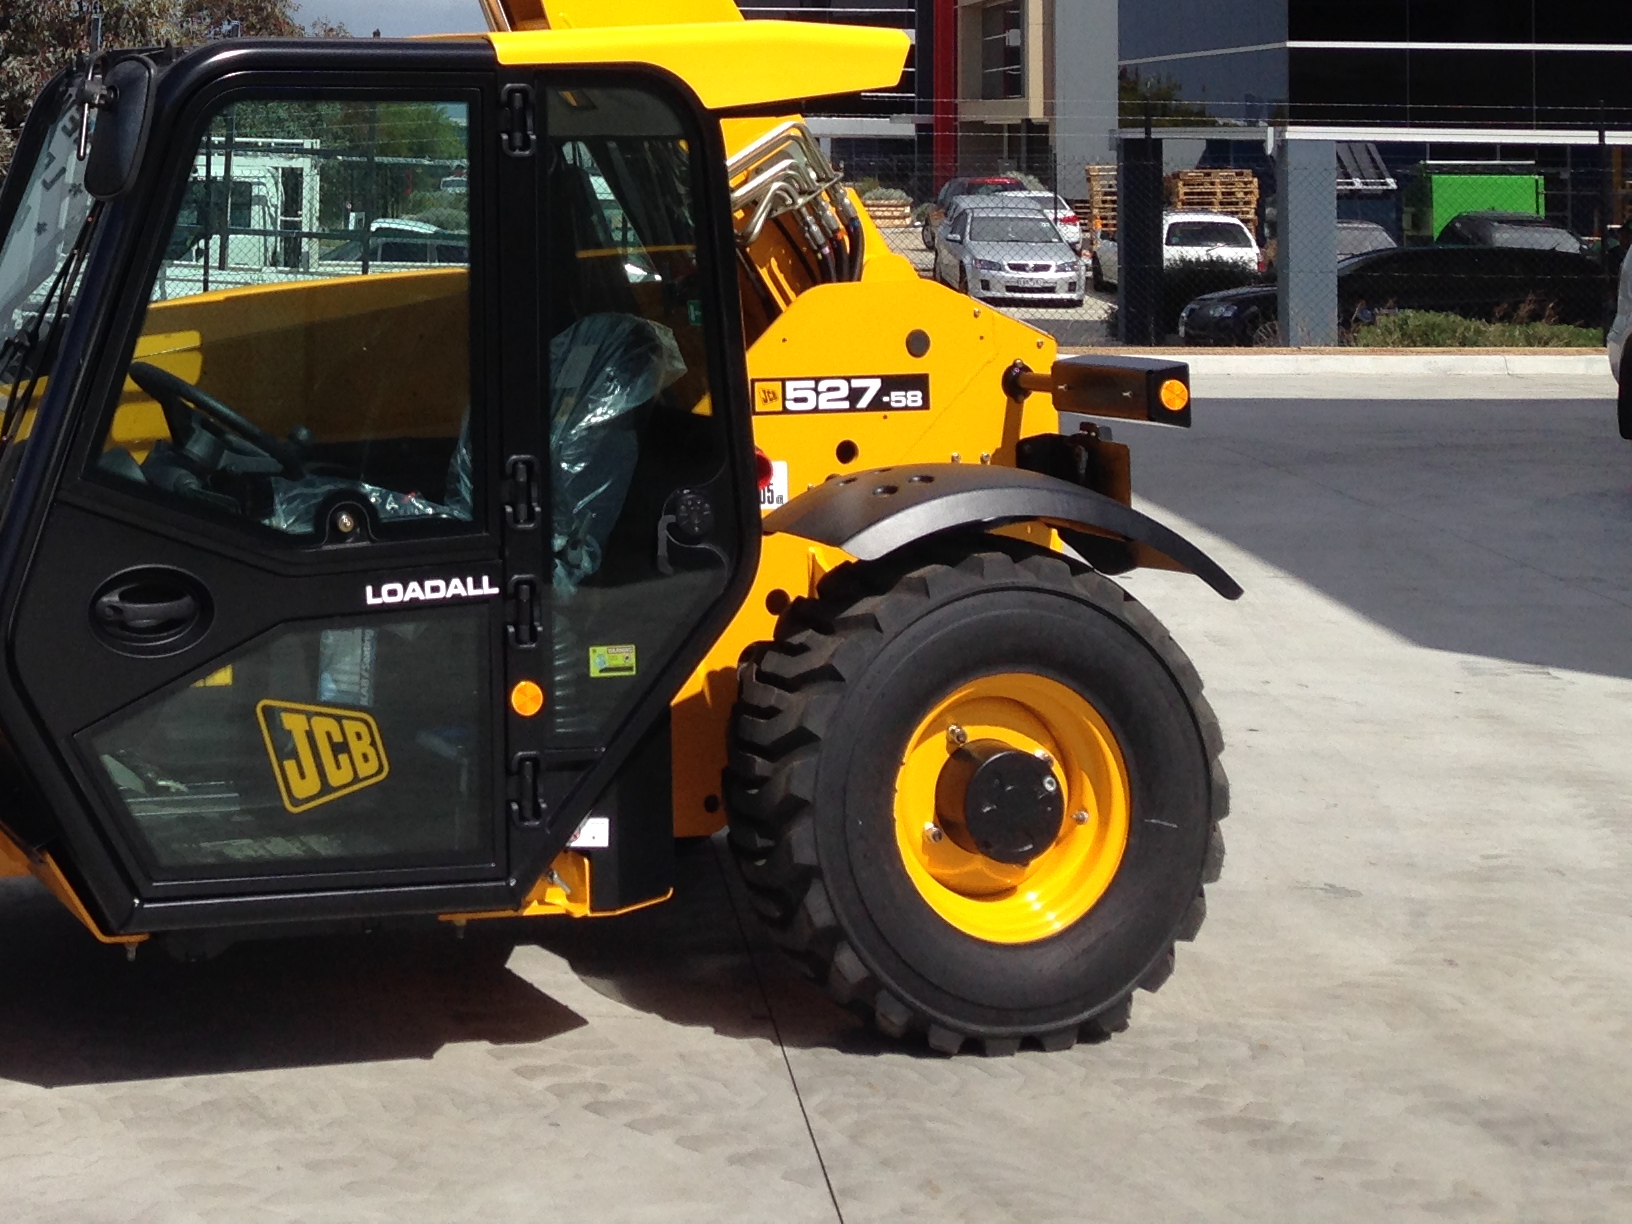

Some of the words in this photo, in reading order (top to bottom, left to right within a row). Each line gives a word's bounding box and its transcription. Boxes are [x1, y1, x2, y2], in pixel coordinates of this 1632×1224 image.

[785, 377, 923, 410] 527-58
[365, 575, 500, 605] LOADALL
[280, 711, 380, 799] JCB
